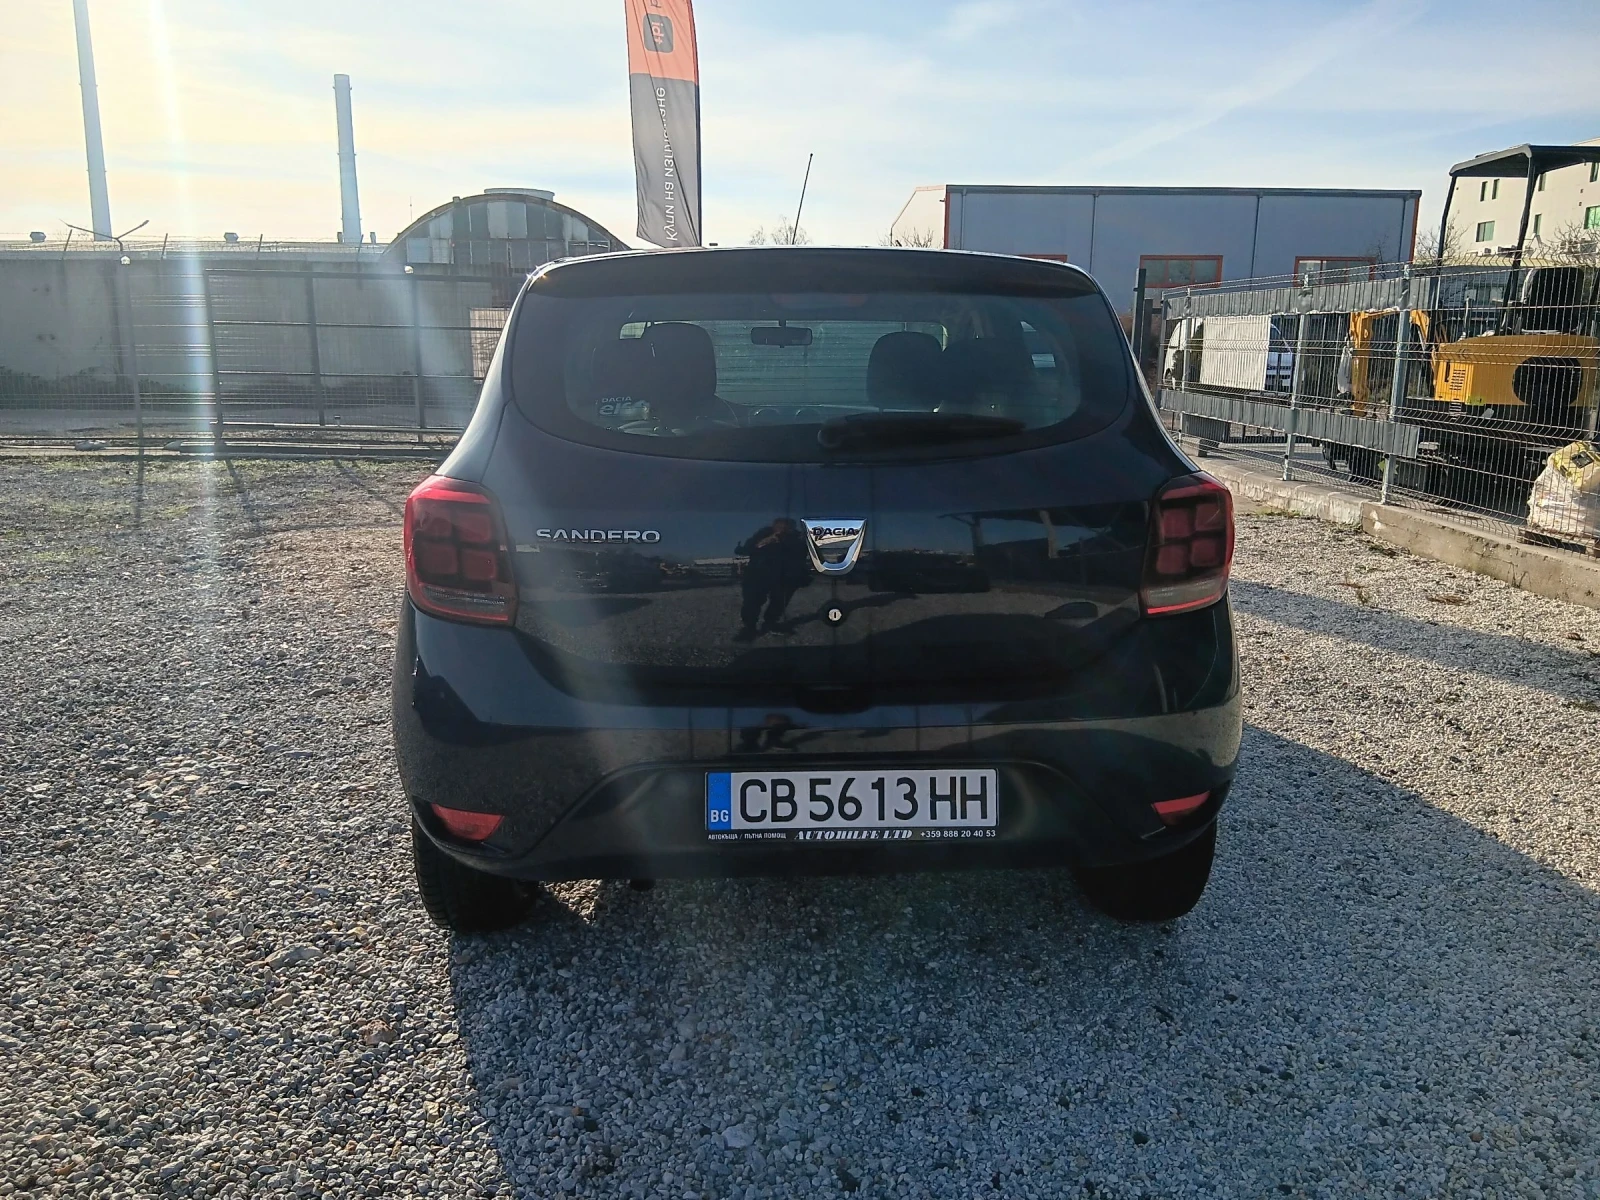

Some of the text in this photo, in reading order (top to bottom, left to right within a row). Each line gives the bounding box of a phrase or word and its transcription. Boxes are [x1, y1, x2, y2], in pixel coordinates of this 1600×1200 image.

[535, 528, 661, 543] SANDERO
[811, 527, 858, 536] DACIA
[710, 809, 729, 823] BG
[882, 829, 913, 840] LTD
[920, 829, 996, 838] +359 888 20 40 53
